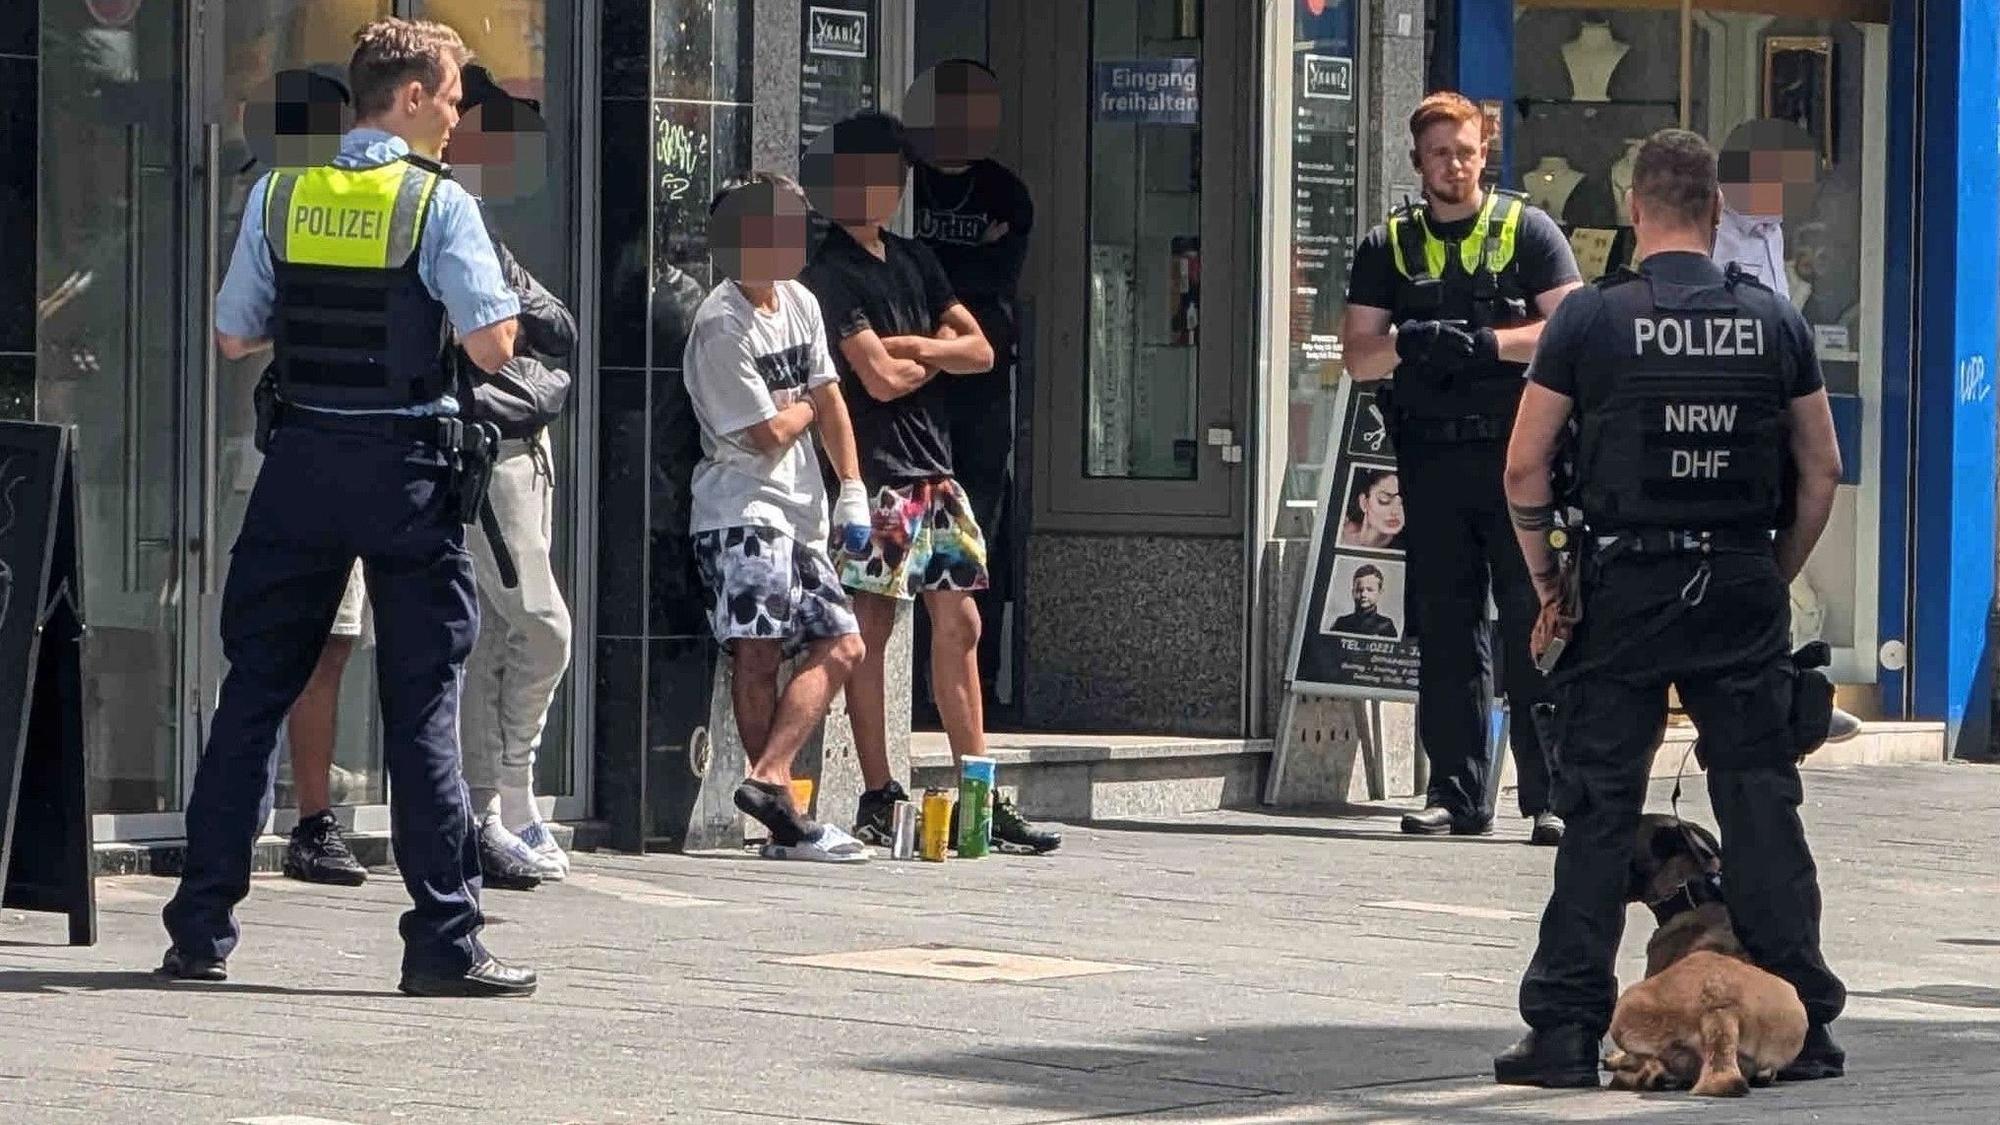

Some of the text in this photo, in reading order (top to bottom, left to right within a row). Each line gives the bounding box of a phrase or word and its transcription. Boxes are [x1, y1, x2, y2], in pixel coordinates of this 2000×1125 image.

[1112, 68, 1197, 92] Eingang
[1101, 92, 1199, 112] freihalten
[294, 205, 384, 240] POLIZEI
[1634, 318, 1764, 356] POLIZEI
[1665, 405, 1738, 432] NRW
[1671, 450, 1731, 479] DHF
